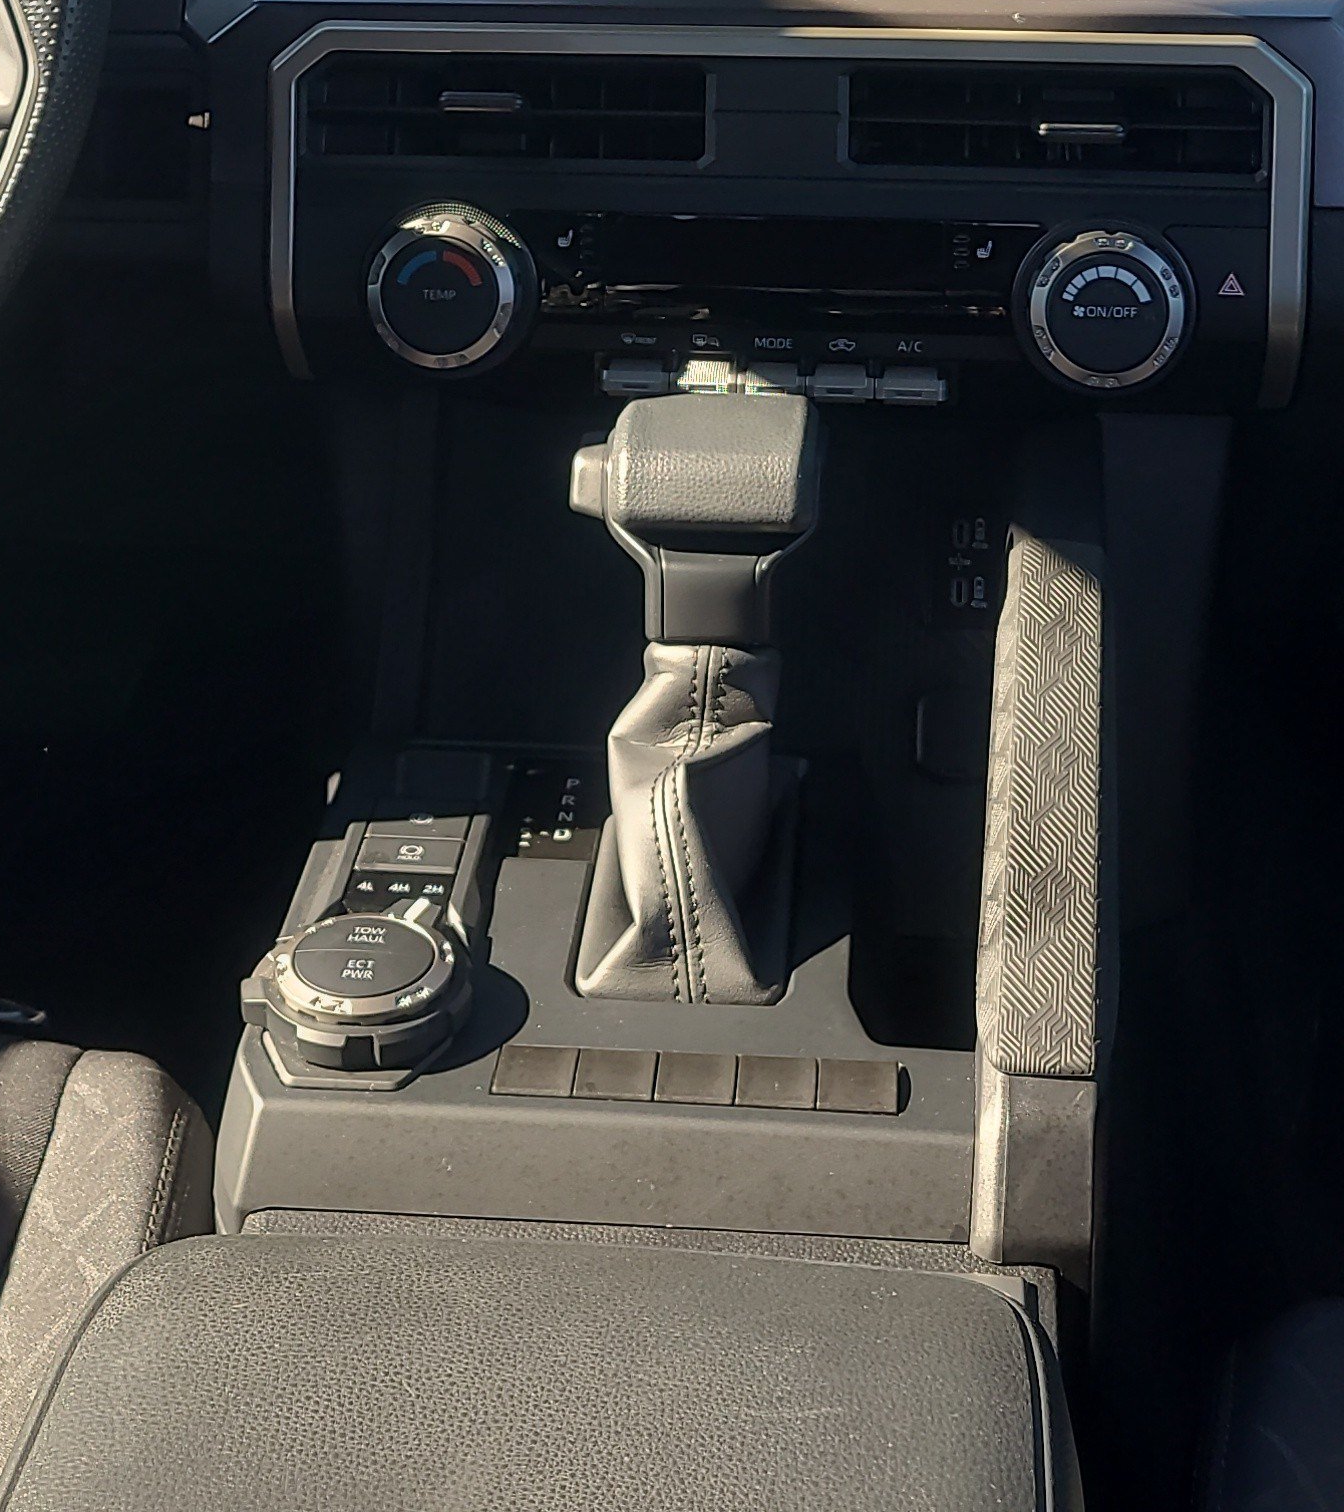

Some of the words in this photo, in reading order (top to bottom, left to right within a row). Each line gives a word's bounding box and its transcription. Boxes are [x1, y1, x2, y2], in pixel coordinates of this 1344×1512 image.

[422, 289, 457, 301] TEMP
[1086, 306, 1138, 318] ON/OFF
[754, 337, 794, 349] MODE
[897, 340, 924, 353] A/C
[566, 778, 580, 789] P
[561, 794, 575, 806] R
[558, 811, 574, 822] N
[553, 828, 573, 841] D
[387, 882, 411, 894] 4H
[421, 884, 445, 896] 2H
[353, 925, 387, 935] TOW
[346, 934, 386, 945] HAUL
[347, 958, 376, 969] ECT
[340, 968, 375, 981] PWR
